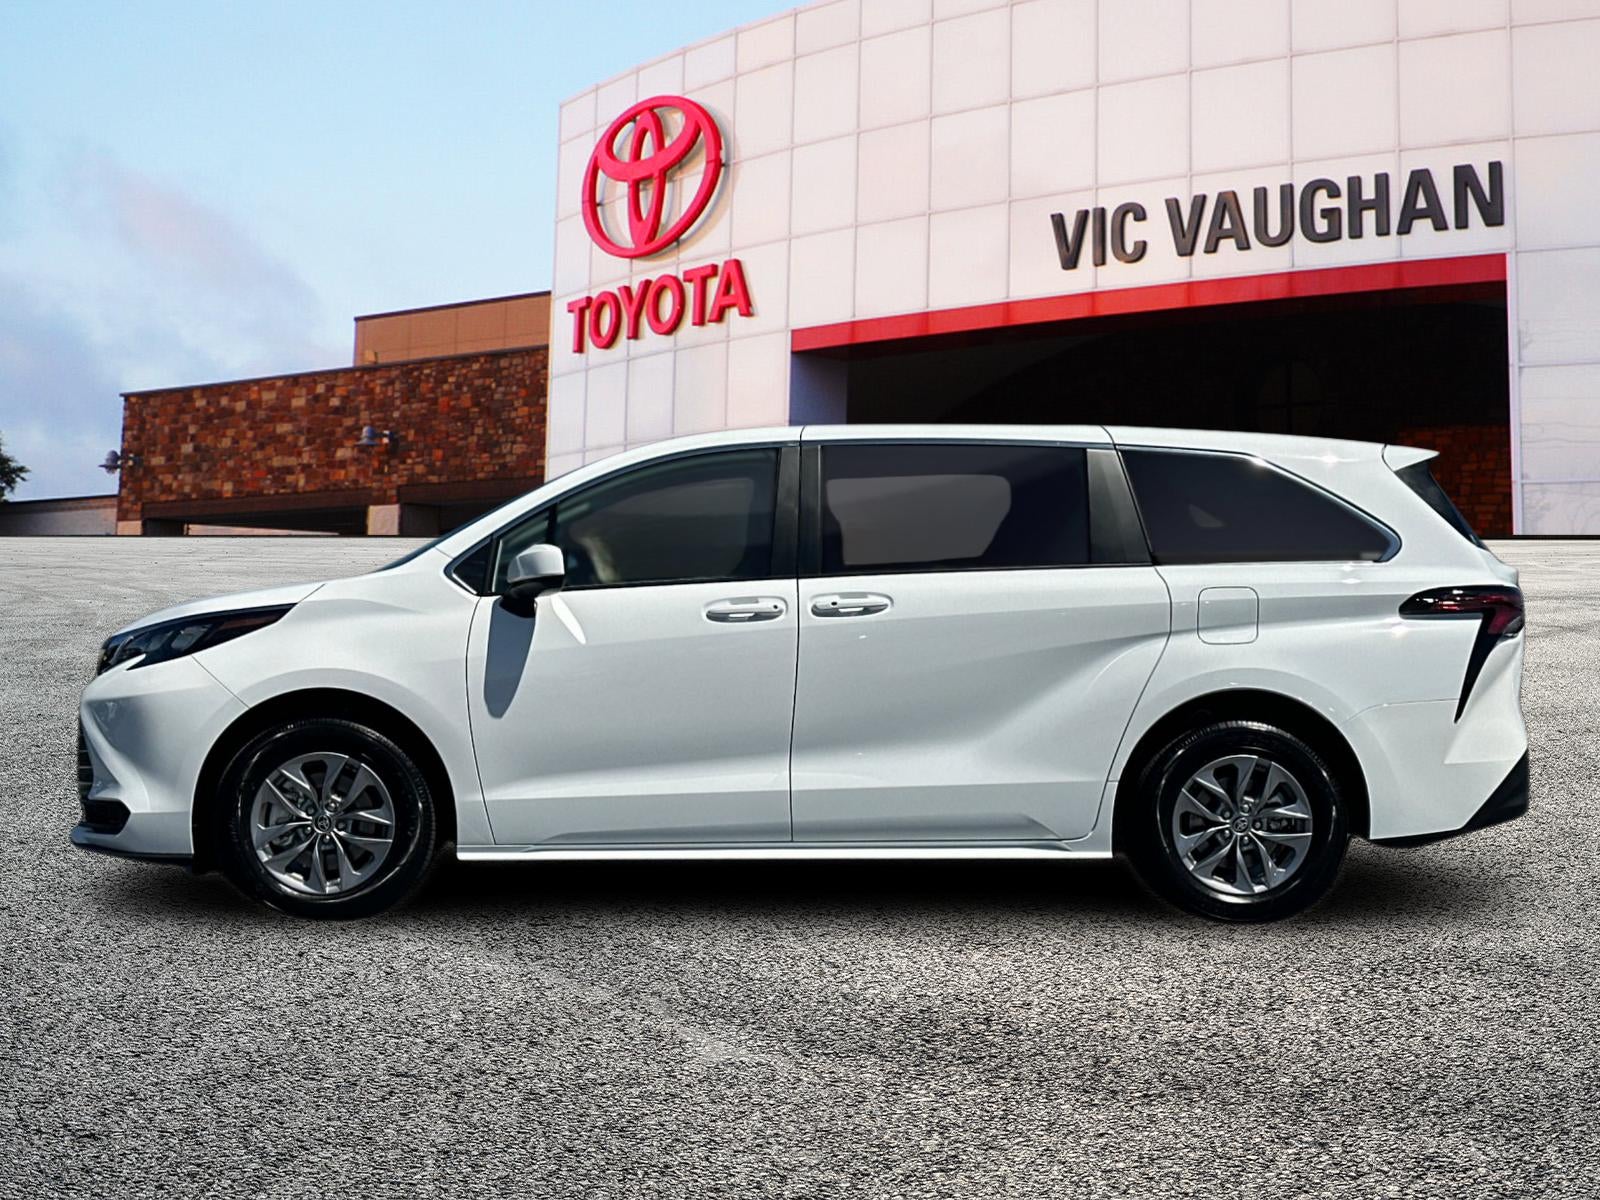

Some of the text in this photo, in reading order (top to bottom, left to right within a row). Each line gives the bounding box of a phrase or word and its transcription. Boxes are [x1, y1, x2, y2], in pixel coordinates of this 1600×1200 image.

[1050, 160, 1504, 270] VIC VAUGHAN
[567, 258, 754, 354] TOYOTA
